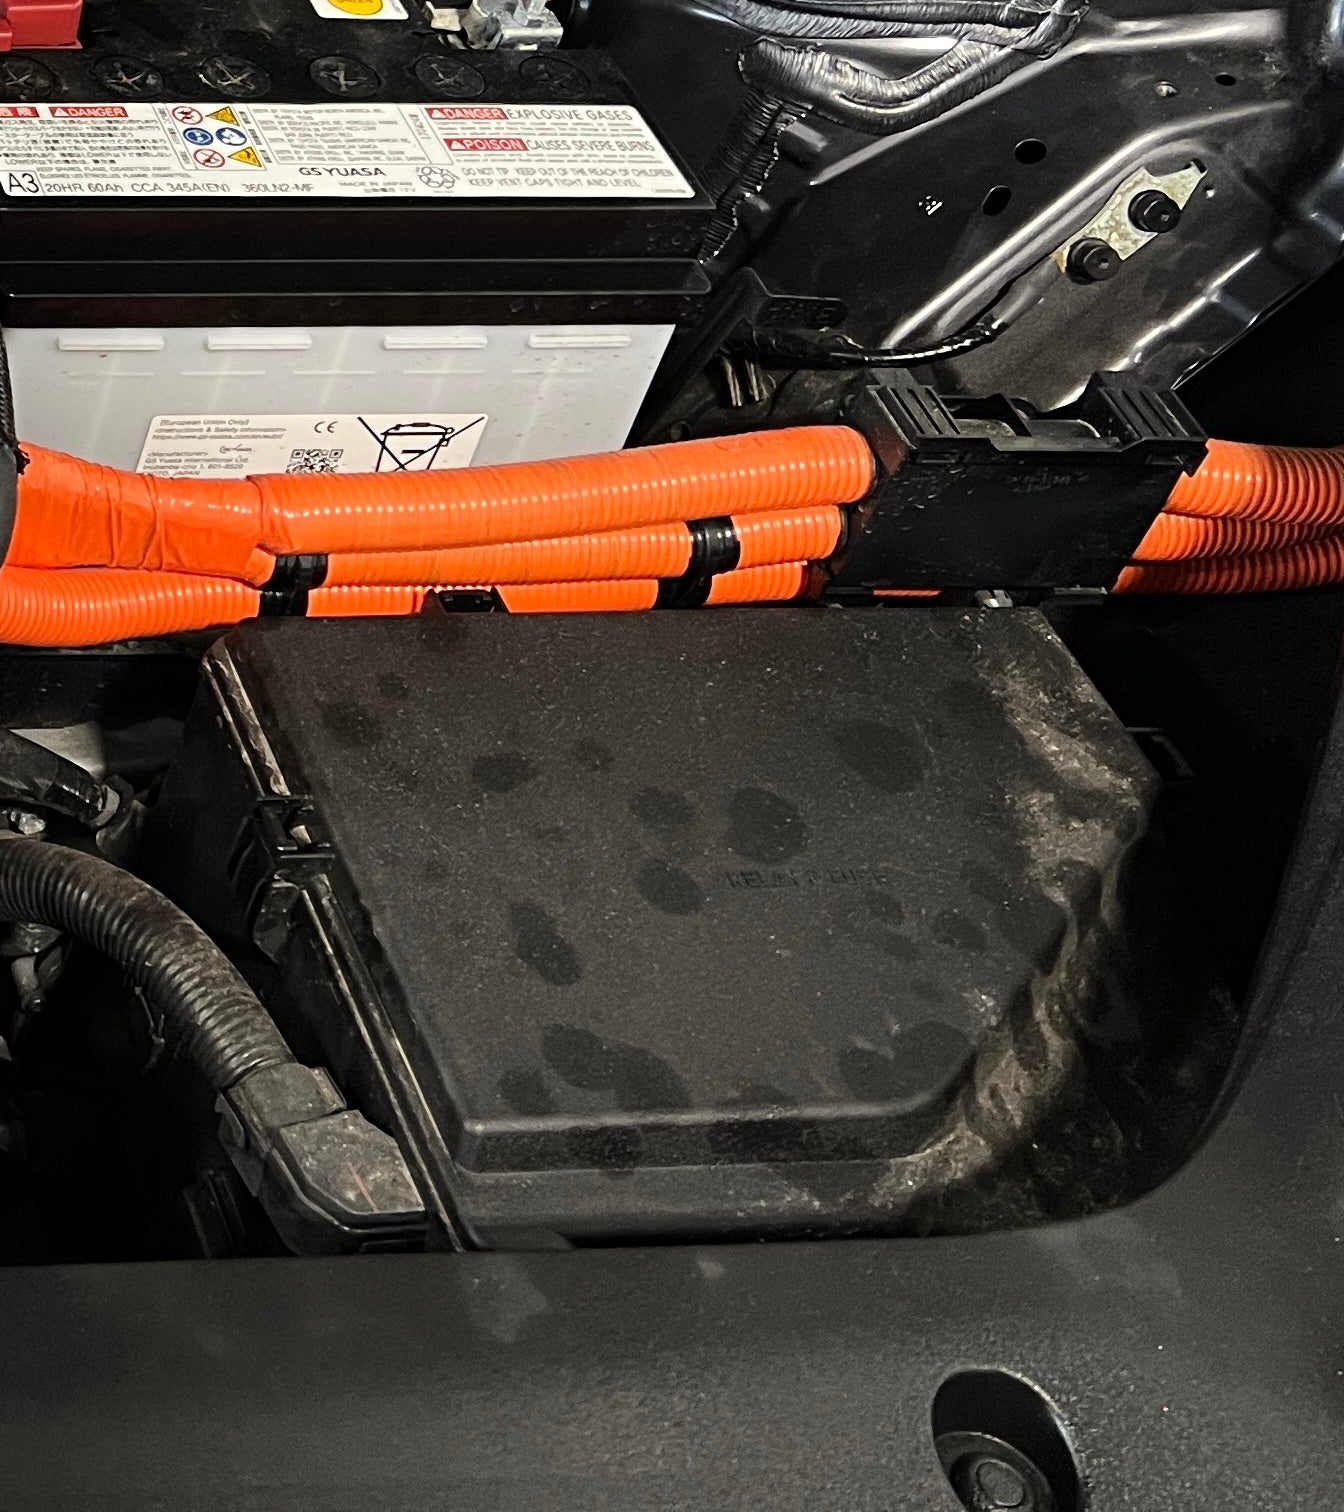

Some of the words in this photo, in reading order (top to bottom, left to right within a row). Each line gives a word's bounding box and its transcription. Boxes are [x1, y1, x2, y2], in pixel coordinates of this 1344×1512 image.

[68, 108, 126, 117] DANGER
[443, 109, 502, 119] DANGER
[508, 110, 580, 120] EXPLOSIVE
[586, 110, 633, 120] GASES
[463, 139, 524, 150] POISON
[528, 140, 571, 150] CAUSES
[574, 141, 615, 151] SEVERE
[617, 141, 655, 151] BURNS
[299, 167, 322, 176] GS
[326, 167, 387, 176] YUASA
[8, 173, 39, 193] A3
[44, 183, 82, 192] 20HR
[87, 183, 124, 192] 60Ah
[130, 183, 164, 192] CCA
[168, 182, 230, 193] 345A(EN)
